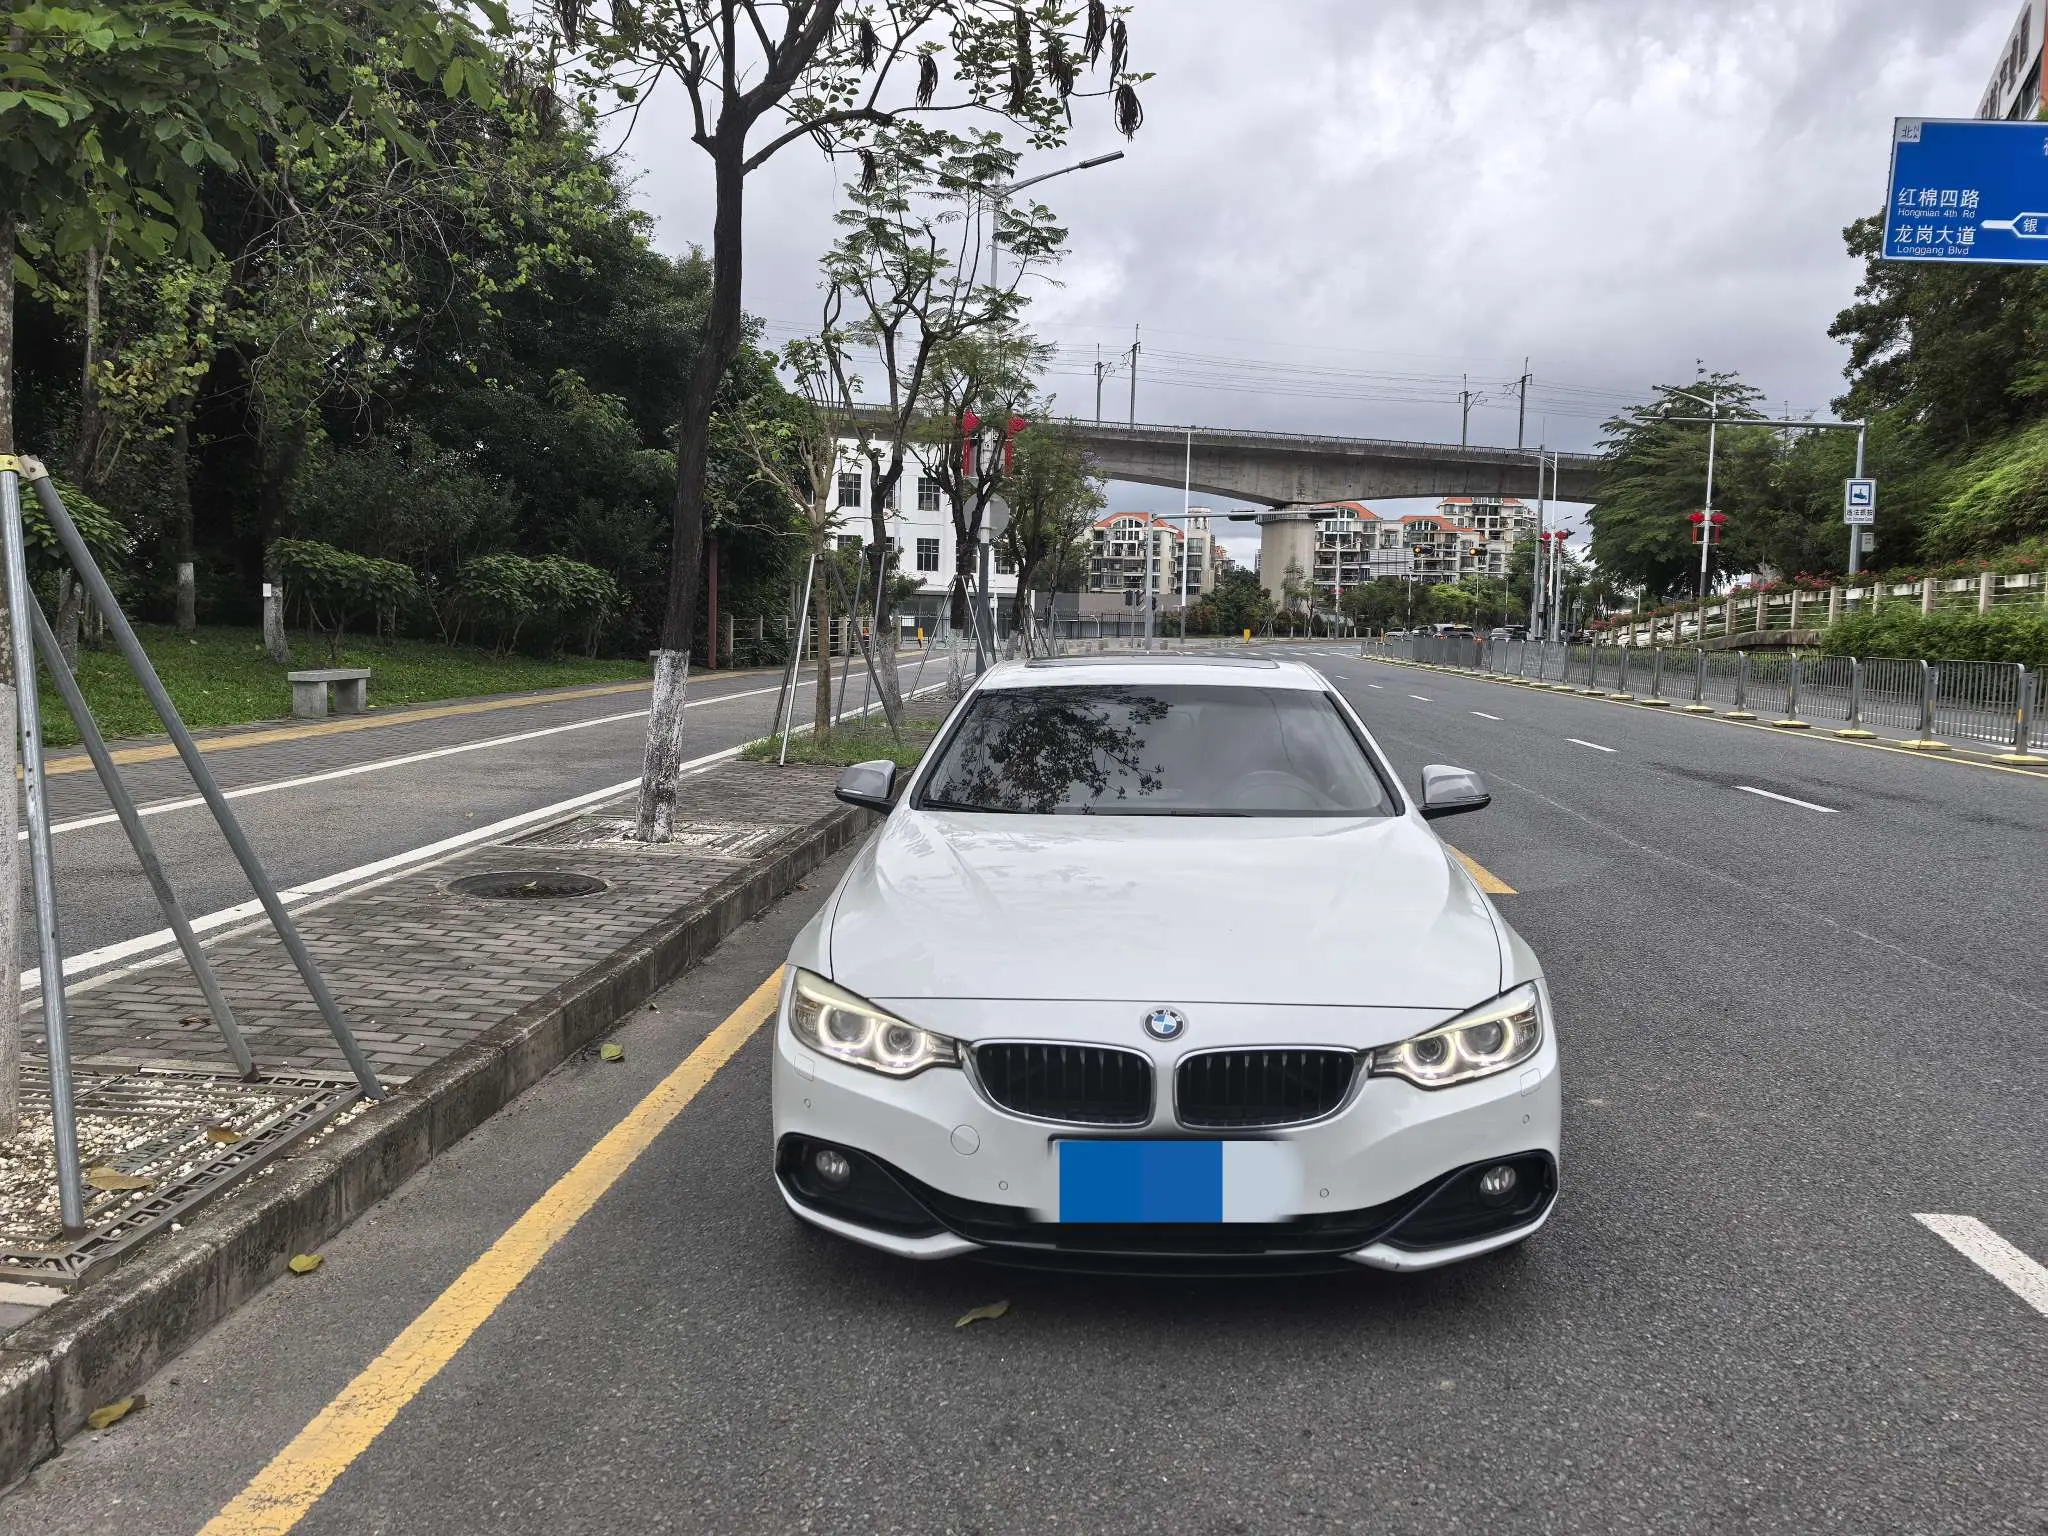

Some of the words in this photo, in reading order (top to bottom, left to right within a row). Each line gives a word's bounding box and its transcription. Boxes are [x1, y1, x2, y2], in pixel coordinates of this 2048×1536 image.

[1898, 187, 1980, 209] 红棉四路
[1898, 208, 1940, 219] Hongmian
[1943, 209, 1958, 217] 4th
[1962, 209, 1976, 219] Rd
[1894, 224, 1977, 245] 龙岗大道
[1897, 244, 1944, 256] Longgang
[1948, 245, 1969, 255] Blvd
